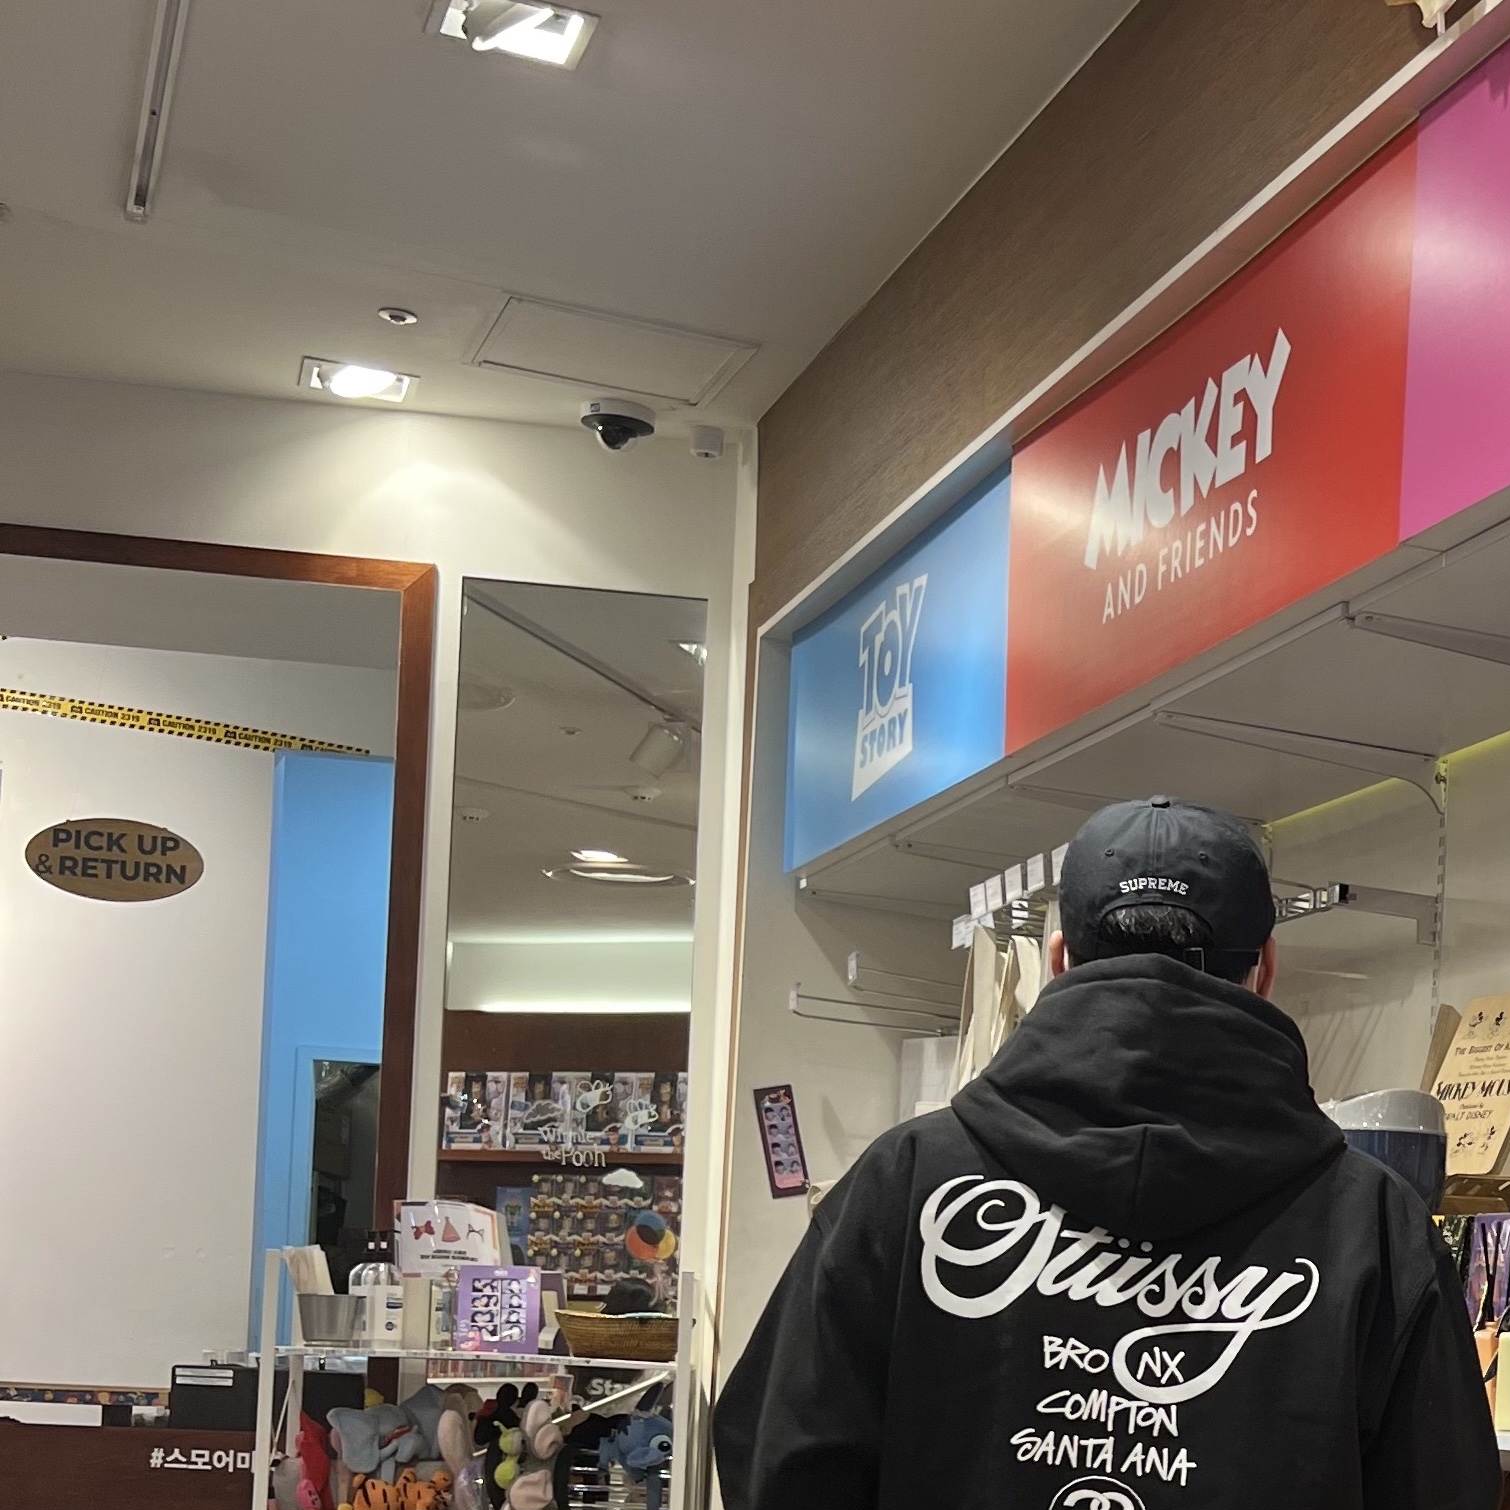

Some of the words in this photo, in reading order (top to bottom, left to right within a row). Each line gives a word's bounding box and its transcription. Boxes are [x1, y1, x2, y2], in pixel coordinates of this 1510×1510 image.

[1084, 328, 1292, 571] MICKEY
[1103, 562, 1147, 624] AND
[1157, 489, 1258, 591] FRIENDS
[859, 573, 928, 730] TOY
[84, 707, 118, 720] CAUTION
[161, 720, 195, 732] CAUTION
[238, 732, 271, 745] CAUTION
[859, 707, 909, 769] STORY
[52, 828, 127, 854] PICK
[137, 834, 180, 856] UP
[35, 853, 53, 876] &
[58, 855, 187, 886] RETURN
[1119, 876, 1190, 896] SUPREME
[561, 1143, 607, 1167] Pooh
[1036, 1389, 1178, 1437] COMPTON
[1010, 1427, 1114, 1474] SANTA
[1121, 1442, 1198, 1487] ANA
